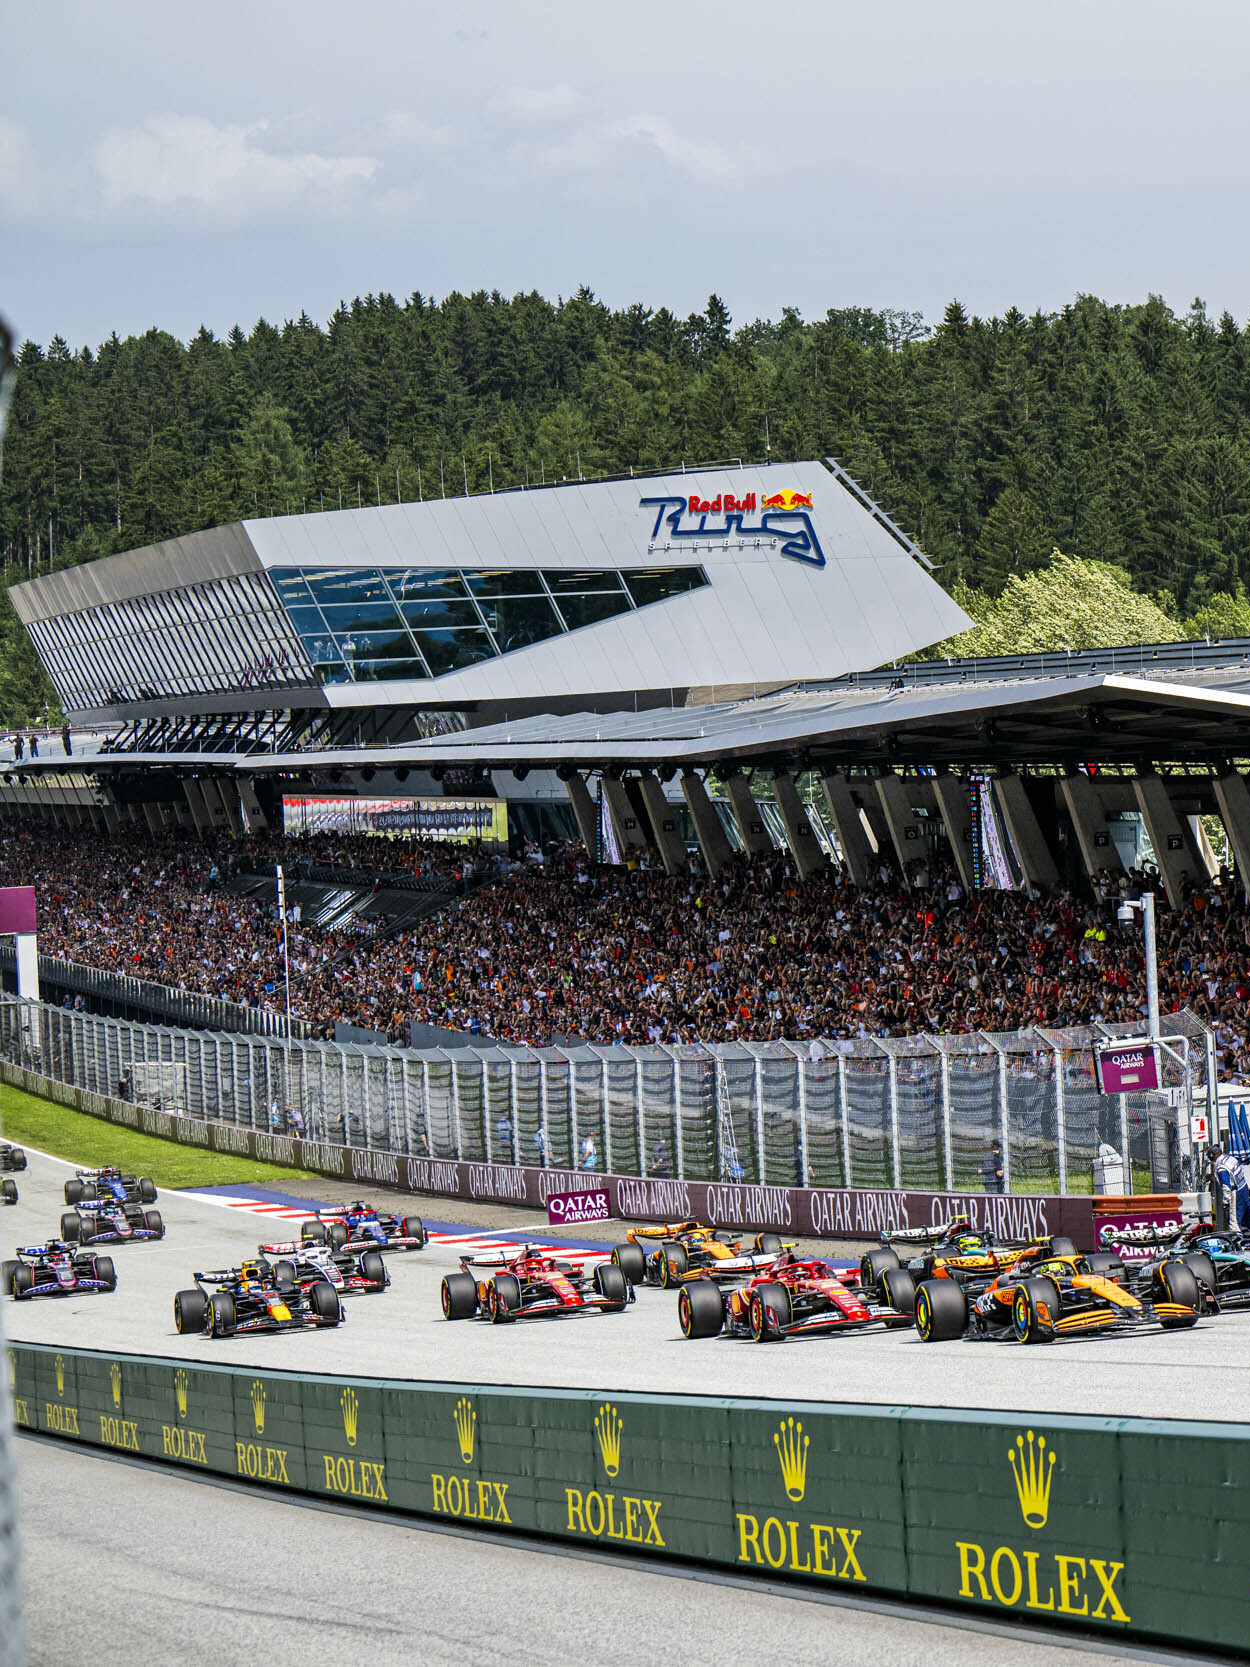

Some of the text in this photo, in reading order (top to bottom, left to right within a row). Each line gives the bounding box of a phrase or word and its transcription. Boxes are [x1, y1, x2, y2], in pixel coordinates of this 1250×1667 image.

[689, 492, 756, 513] Red Bull
[1111, 1052, 1144, 1066] QATAR
[1120, 1060, 1145, 1069] AIRWAYS
[407, 1158, 460, 1193] QATAR AIRWAYS
[468, 1165, 527, 1200] QATAR AIRWAYS
[538, 1171, 566, 1207] QATAR
[550, 1194, 608, 1215] QATAR
[564, 1208, 609, 1222] AIRWAYS
[617, 1179, 692, 1217] QATAR AIRWAYS
[706, 1185, 792, 1226] QATAR AIRWAYS
[810, 1191, 910, 1234] QATAR AIRWAYS
[983, 1197, 1048, 1240] AIRWAYS
[1119, 1244, 1165, 1257] AIRWA
[45, 1402, 81, 1435] ROLEX
[100, 1415, 140, 1451] ROLEX
[162, 1425, 208, 1464] ROLEX
[236, 1442, 290, 1484] ROLEX
[323, 1455, 388, 1501] ROLEX
[431, 1473, 512, 1524] ROLEX
[565, 1488, 666, 1547] ROLEX
[736, 1514, 867, 1582] ROLEX
[955, 1541, 1131, 1623] ROLEX
